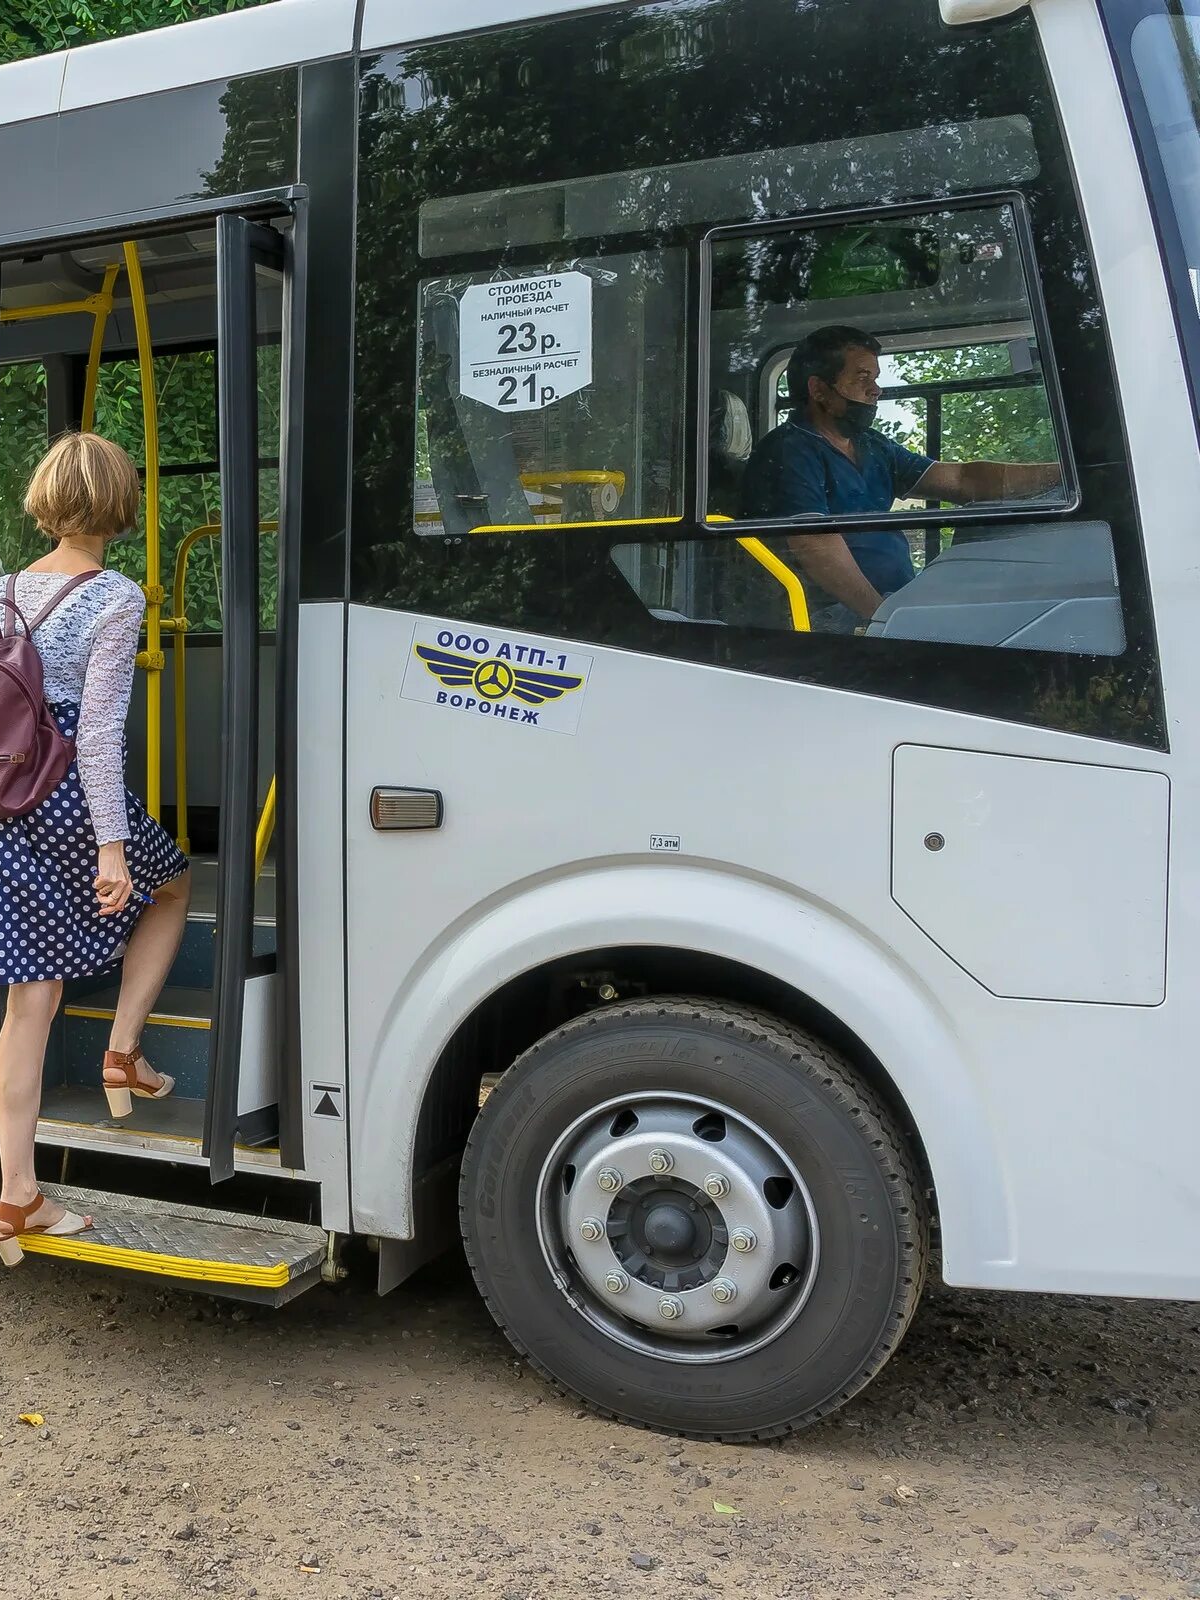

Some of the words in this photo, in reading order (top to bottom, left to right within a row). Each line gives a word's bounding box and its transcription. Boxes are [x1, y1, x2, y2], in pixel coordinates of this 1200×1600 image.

[488, 278, 562, 297] СТОИМОСТЬ
[497, 291, 553, 307] ПРОЕЗДА
[480, 307, 533, 322] НАЛИЧНЫЙ
[534, 303, 570, 315] РАСЧЕТ
[472, 361, 542, 378] БЕЗНАЛИЧНЫЙ
[543, 358, 578, 370] РАСЧЕТ
[436, 630, 490, 655] ООО
[495, 642, 567, 671] АТП-1
[436, 691, 541, 725] ВОРОНЕЖ
[652, 837, 663, 848] 7,3
[664, 840, 678, 848] атм
